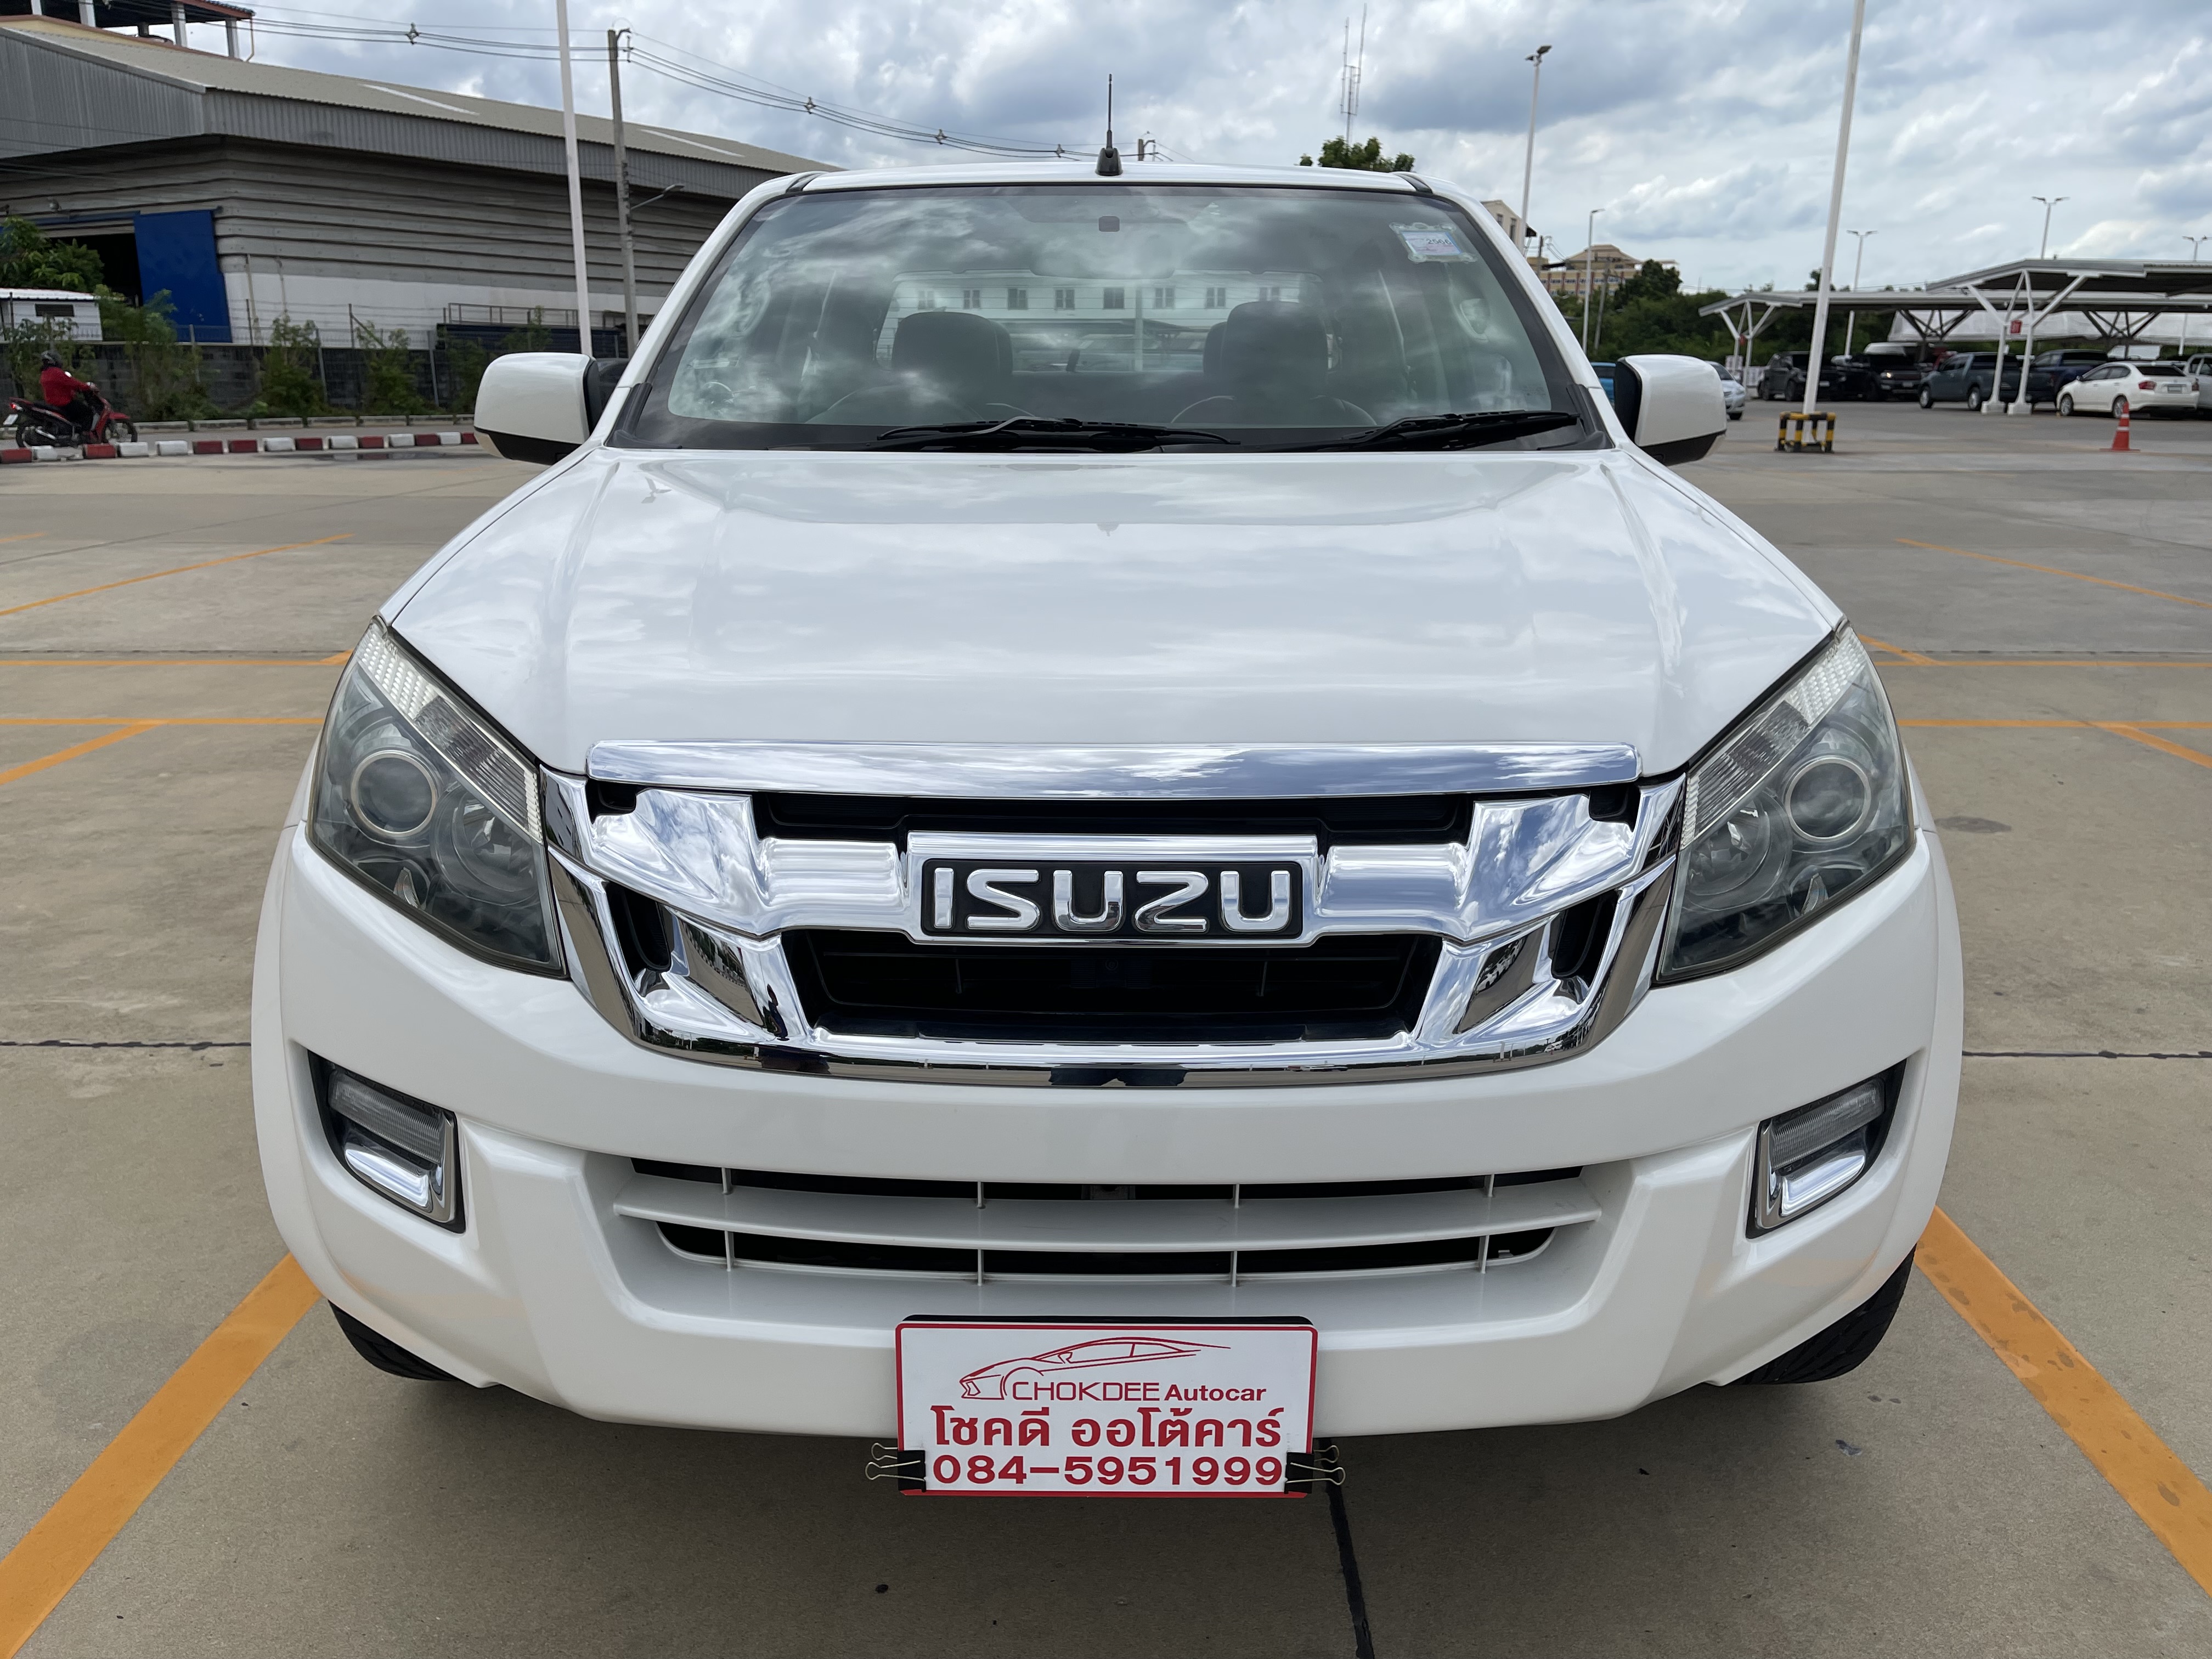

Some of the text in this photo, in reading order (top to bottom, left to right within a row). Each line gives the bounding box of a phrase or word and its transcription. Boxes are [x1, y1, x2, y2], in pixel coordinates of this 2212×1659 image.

[934, 867, 1291, 932] ISUZU
[1012, 1381, 1267, 1401] CHOKDEE Autocar
[930, 1405, 1284, 1448] โชคดี ออโต้คาร์
[933, 1454, 1283, 1486] 084-5951999
